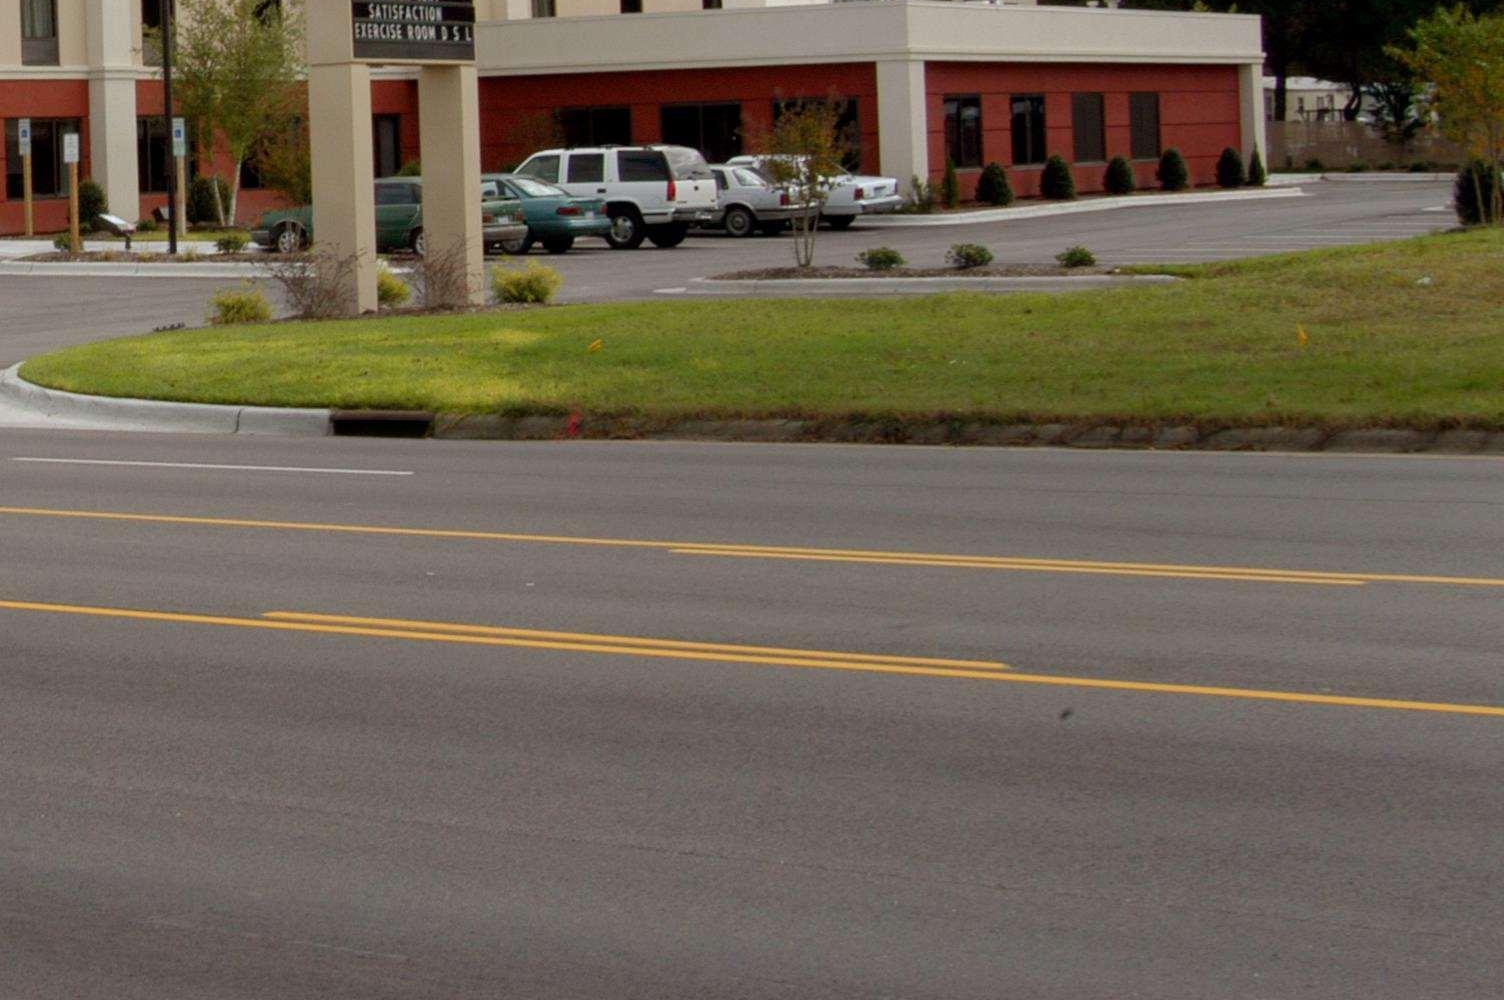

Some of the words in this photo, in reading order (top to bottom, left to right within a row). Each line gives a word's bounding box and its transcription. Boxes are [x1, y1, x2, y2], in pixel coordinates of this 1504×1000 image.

[368, 2, 443, 23] SATISFACTION
[355, 22, 403, 40] EXERCISE
[407, 24, 436, 40] ROOM
